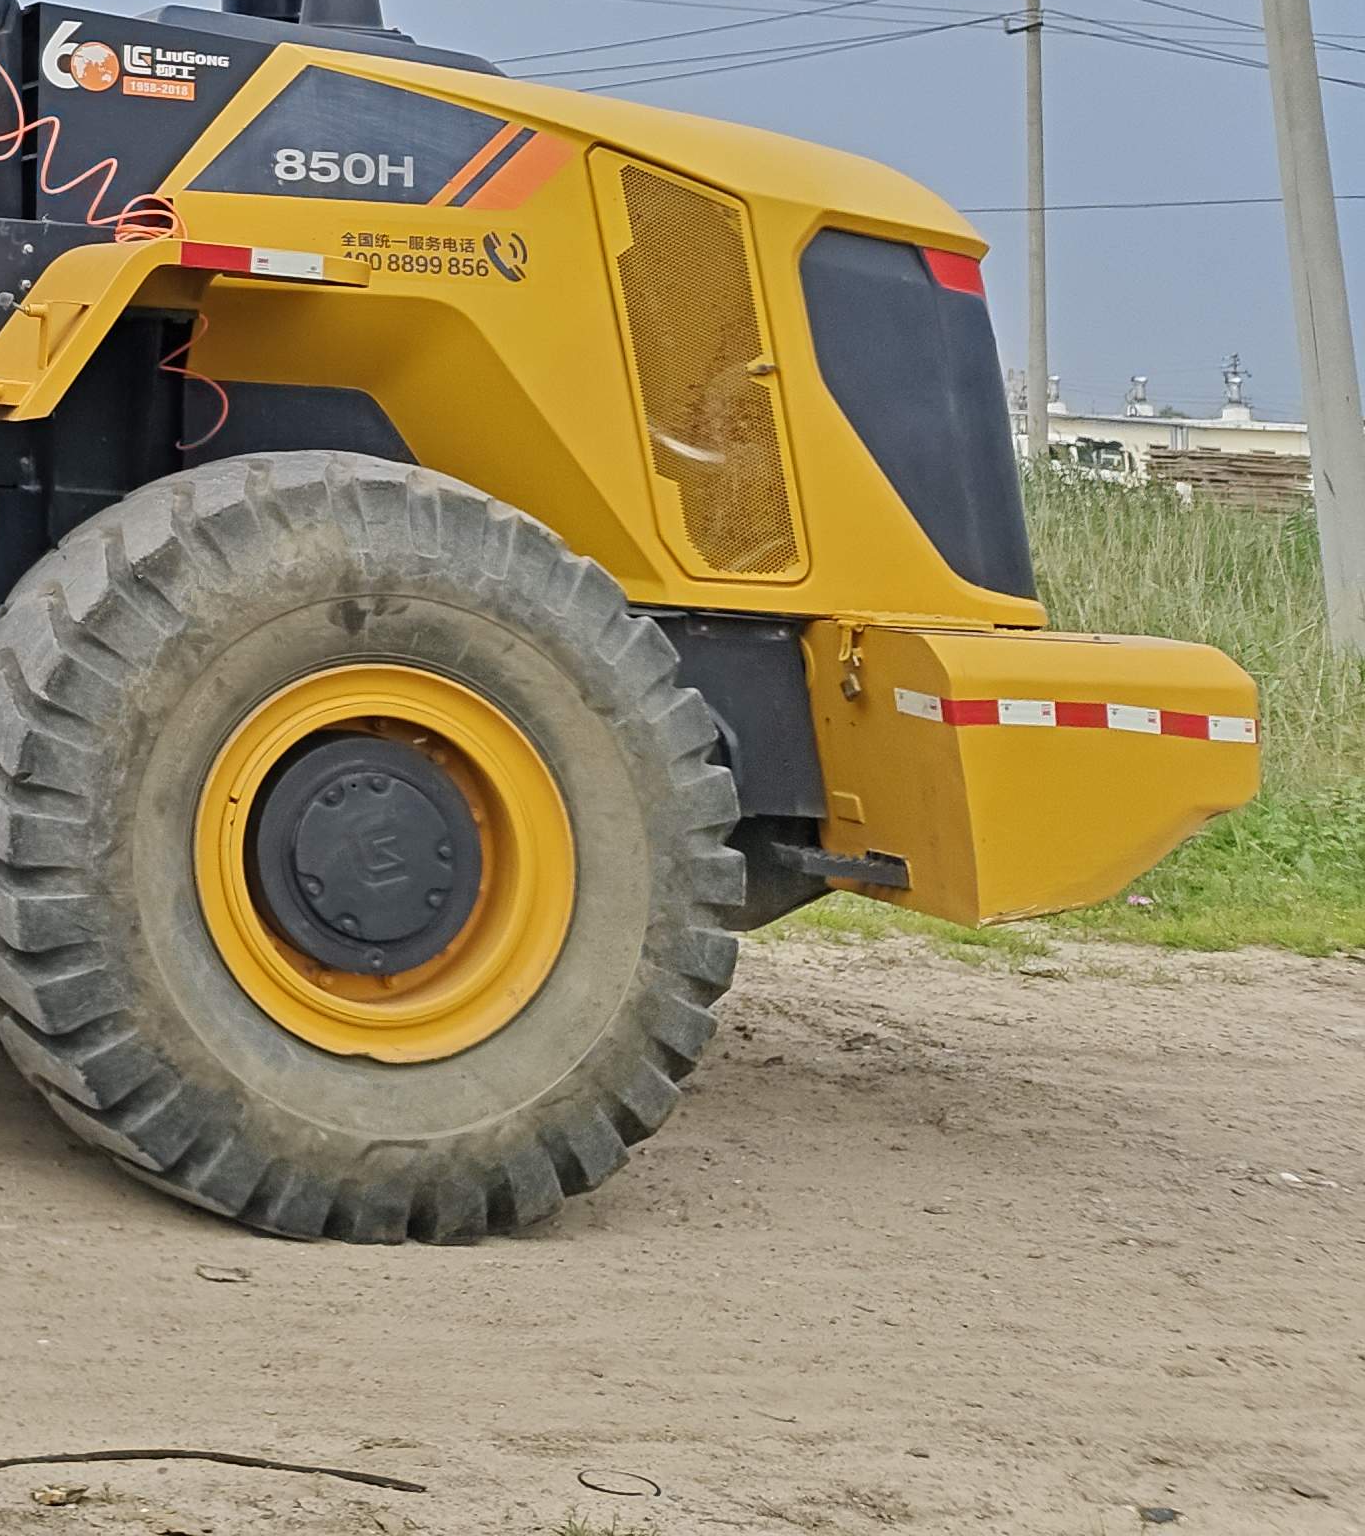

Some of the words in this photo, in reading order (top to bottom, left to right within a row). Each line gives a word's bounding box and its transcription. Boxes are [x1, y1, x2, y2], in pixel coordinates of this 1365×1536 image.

[130, 80, 189, 97] 1958-2018
[274, 148, 414, 188] 850H
[341, 231, 476, 254] 全国统一服务电话
[387, 253, 443, 275] 8899
[447, 257, 490, 277] 856
